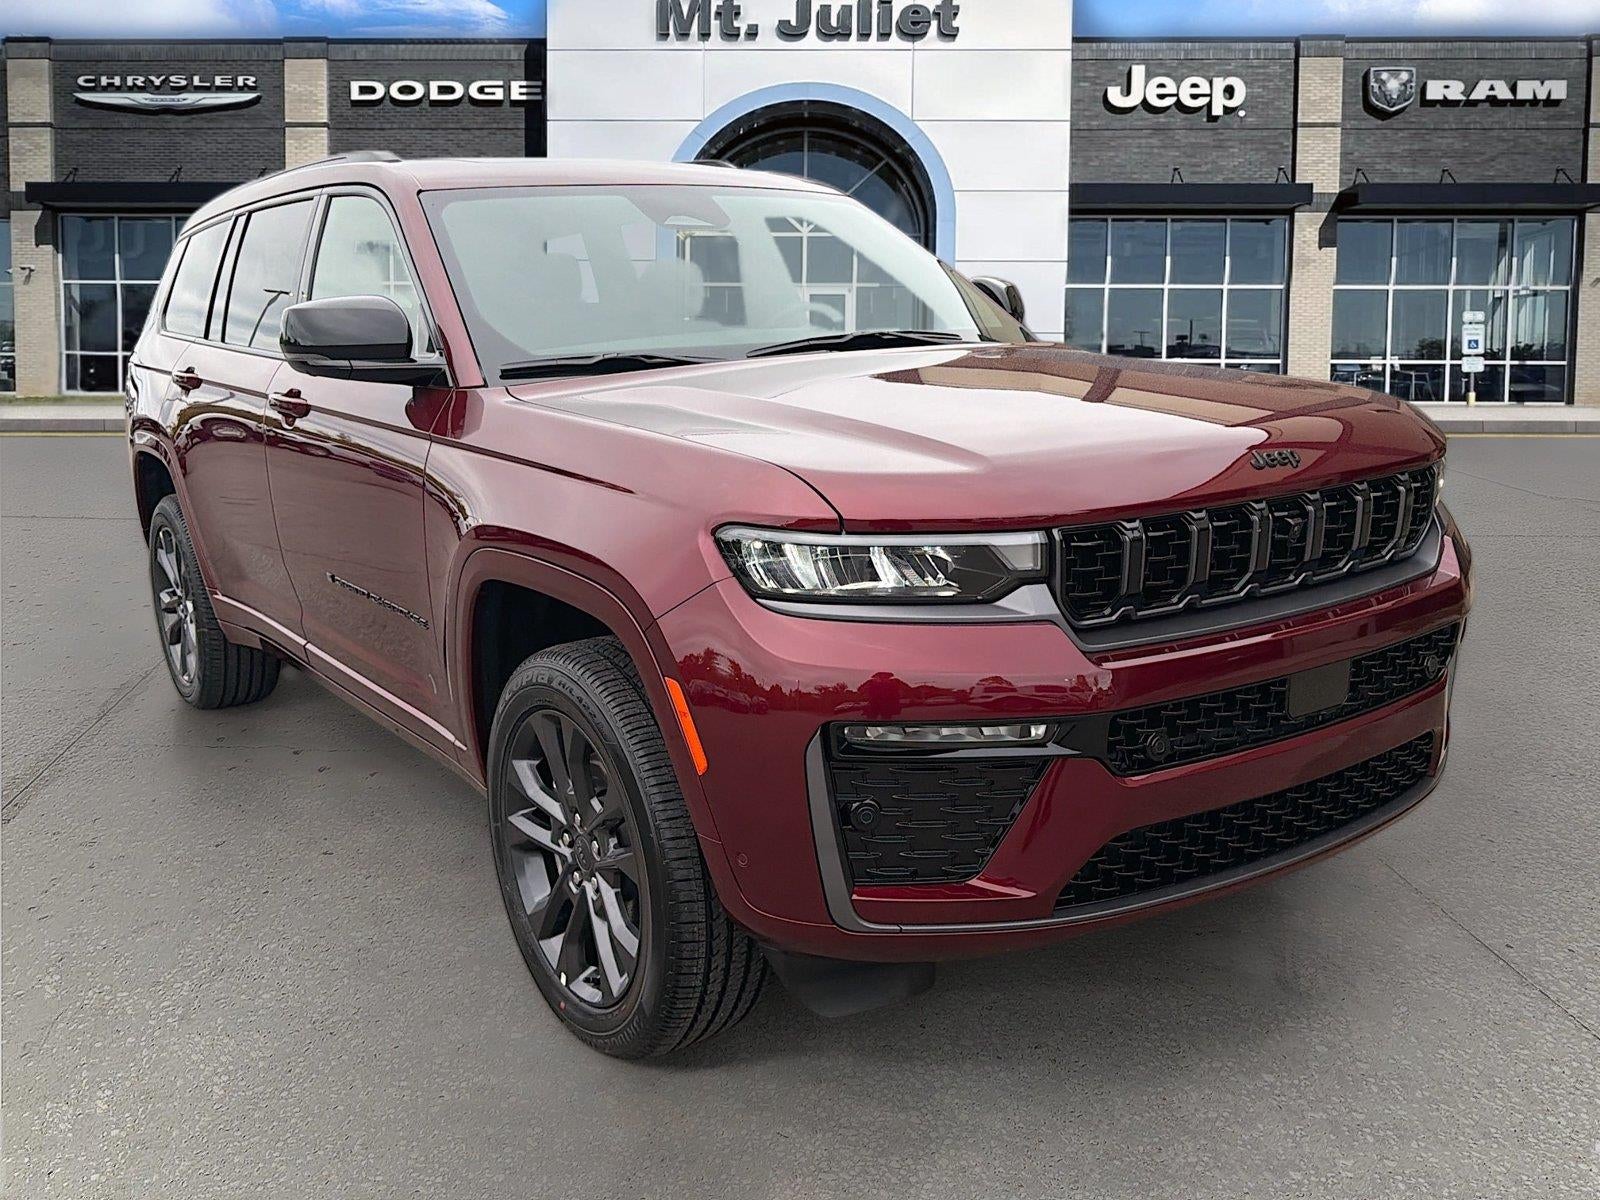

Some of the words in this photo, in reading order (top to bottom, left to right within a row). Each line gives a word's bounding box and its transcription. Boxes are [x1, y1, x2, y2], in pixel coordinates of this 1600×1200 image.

[655, 0, 758, 40] Mt.
[777, 0, 960, 41] Juliet
[76, 74, 257, 89] CHRYSLER
[349, 80, 543, 102] DODGE
[1106, 64, 1247, 117] Jeep
[1424, 79, 1568, 102] RAM
[1250, 449, 1301, 470] Jeep
